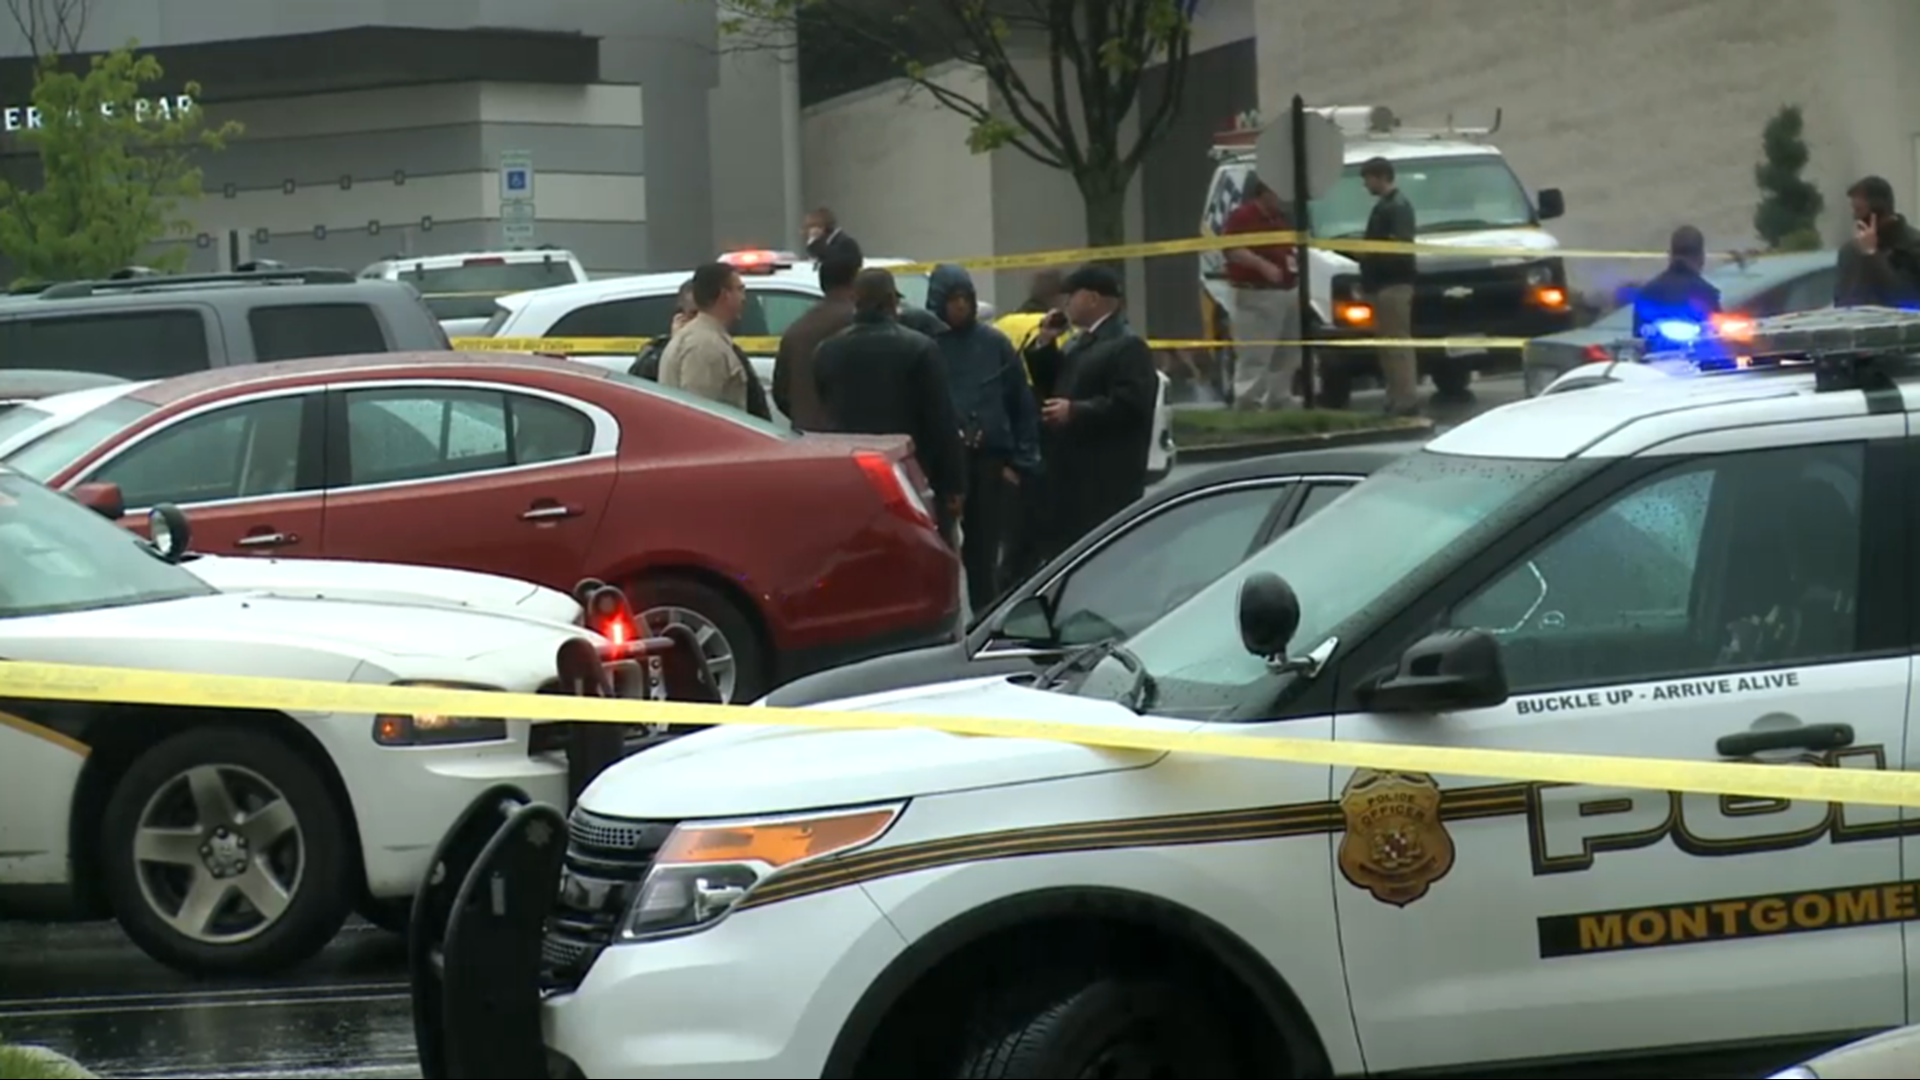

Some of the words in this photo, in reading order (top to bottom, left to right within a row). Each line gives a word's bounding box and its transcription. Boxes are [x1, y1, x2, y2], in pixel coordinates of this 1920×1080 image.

[1516, 692, 1601, 715] BUCKLE
[1606, 688, 1634, 706] UP
[1652, 678, 1731, 701] ARRIVE
[1737, 671, 1800, 693] ALIVE
[1367, 792, 1416, 807] POLICE
[1360, 803, 1426, 828] OFFICER
